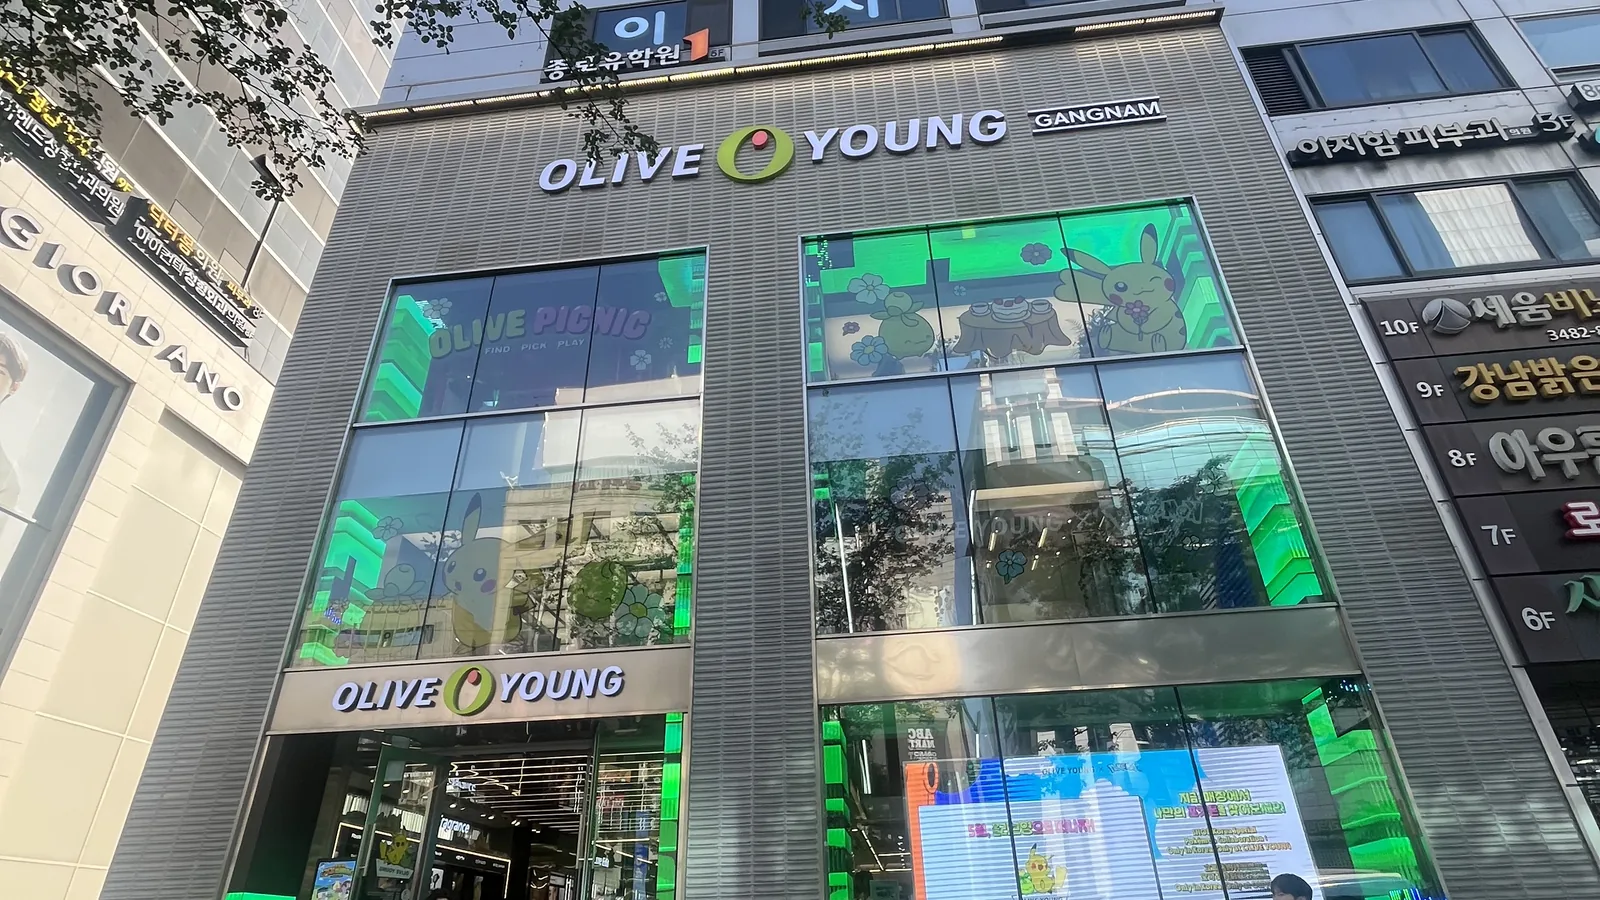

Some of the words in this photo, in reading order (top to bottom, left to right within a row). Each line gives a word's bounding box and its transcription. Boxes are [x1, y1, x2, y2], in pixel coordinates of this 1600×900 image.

[1034, 99, 1162, 129] GANGNAM
[538, 143, 705, 193] OLIVE
[803, 108, 1007, 163] YOUNG
[0, 206, 244, 412] GIORDANO
[428, 308, 526, 360] OLIVE
[533, 304, 653, 340] PICNIC
[1380, 319, 1420, 337] 10F
[484, 344, 511, 355] FIND
[521, 341, 548, 351] PICK
[557, 337, 585, 348] PLAY
[1415, 381, 1445, 399] 9F
[1447, 448, 1477, 468] 8F
[1481, 524, 1516, 547] 7F
[1521, 607, 1556, 632] 6F
[331, 677, 441, 712] OLIVE
[499, 665, 624, 703] YOUNG
[440, 814, 471, 834] ragrance
